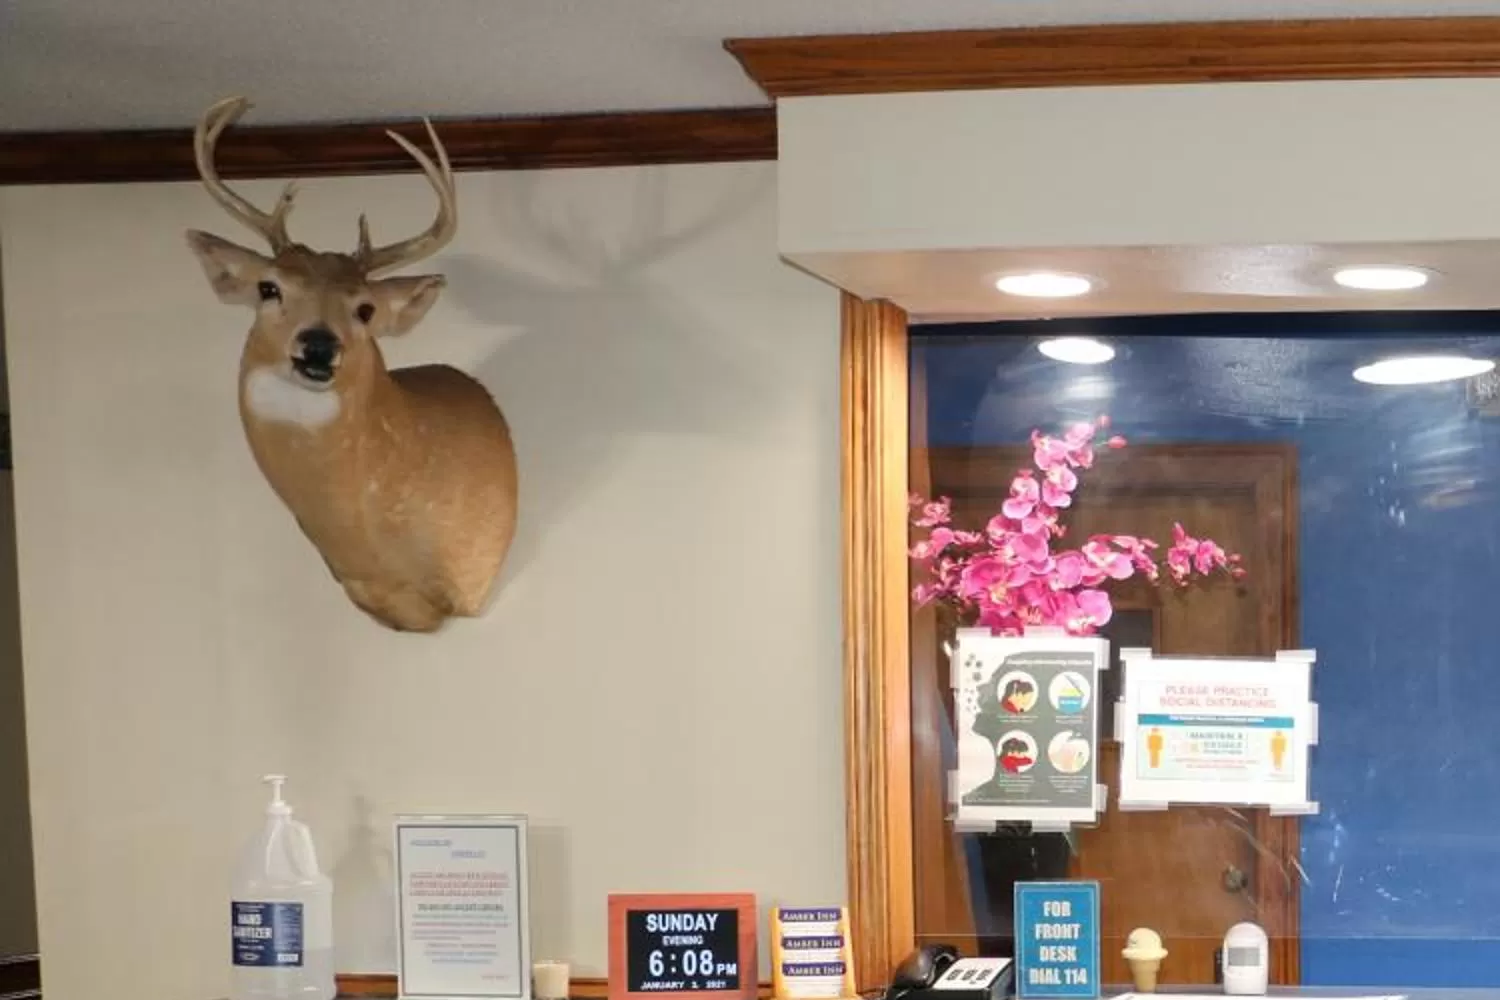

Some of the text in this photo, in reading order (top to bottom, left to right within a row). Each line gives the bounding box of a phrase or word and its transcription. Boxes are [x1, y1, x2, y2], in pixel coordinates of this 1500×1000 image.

[1165, 685, 1268, 697] PLEASE PRACTICE
[1160, 697, 1277, 709] SOCIAL DISTANCING
[1043, 901, 1072, 916] FOR
[783, 911, 837, 920] AMBER INN
[646, 913, 718, 932] SUNDAY
[1035, 923, 1081, 940] FRONT
[662, 935, 704, 946] EVENING
[786, 939, 841, 948] AMBER INN
[1039, 945, 1077, 962] DESK
[649, 950, 737, 977] 6:08 PM
[788, 966, 843, 975] AMBER INN
[1029, 968, 1088, 985] DIAL 114
[640, 981, 685, 990] JANUARY
